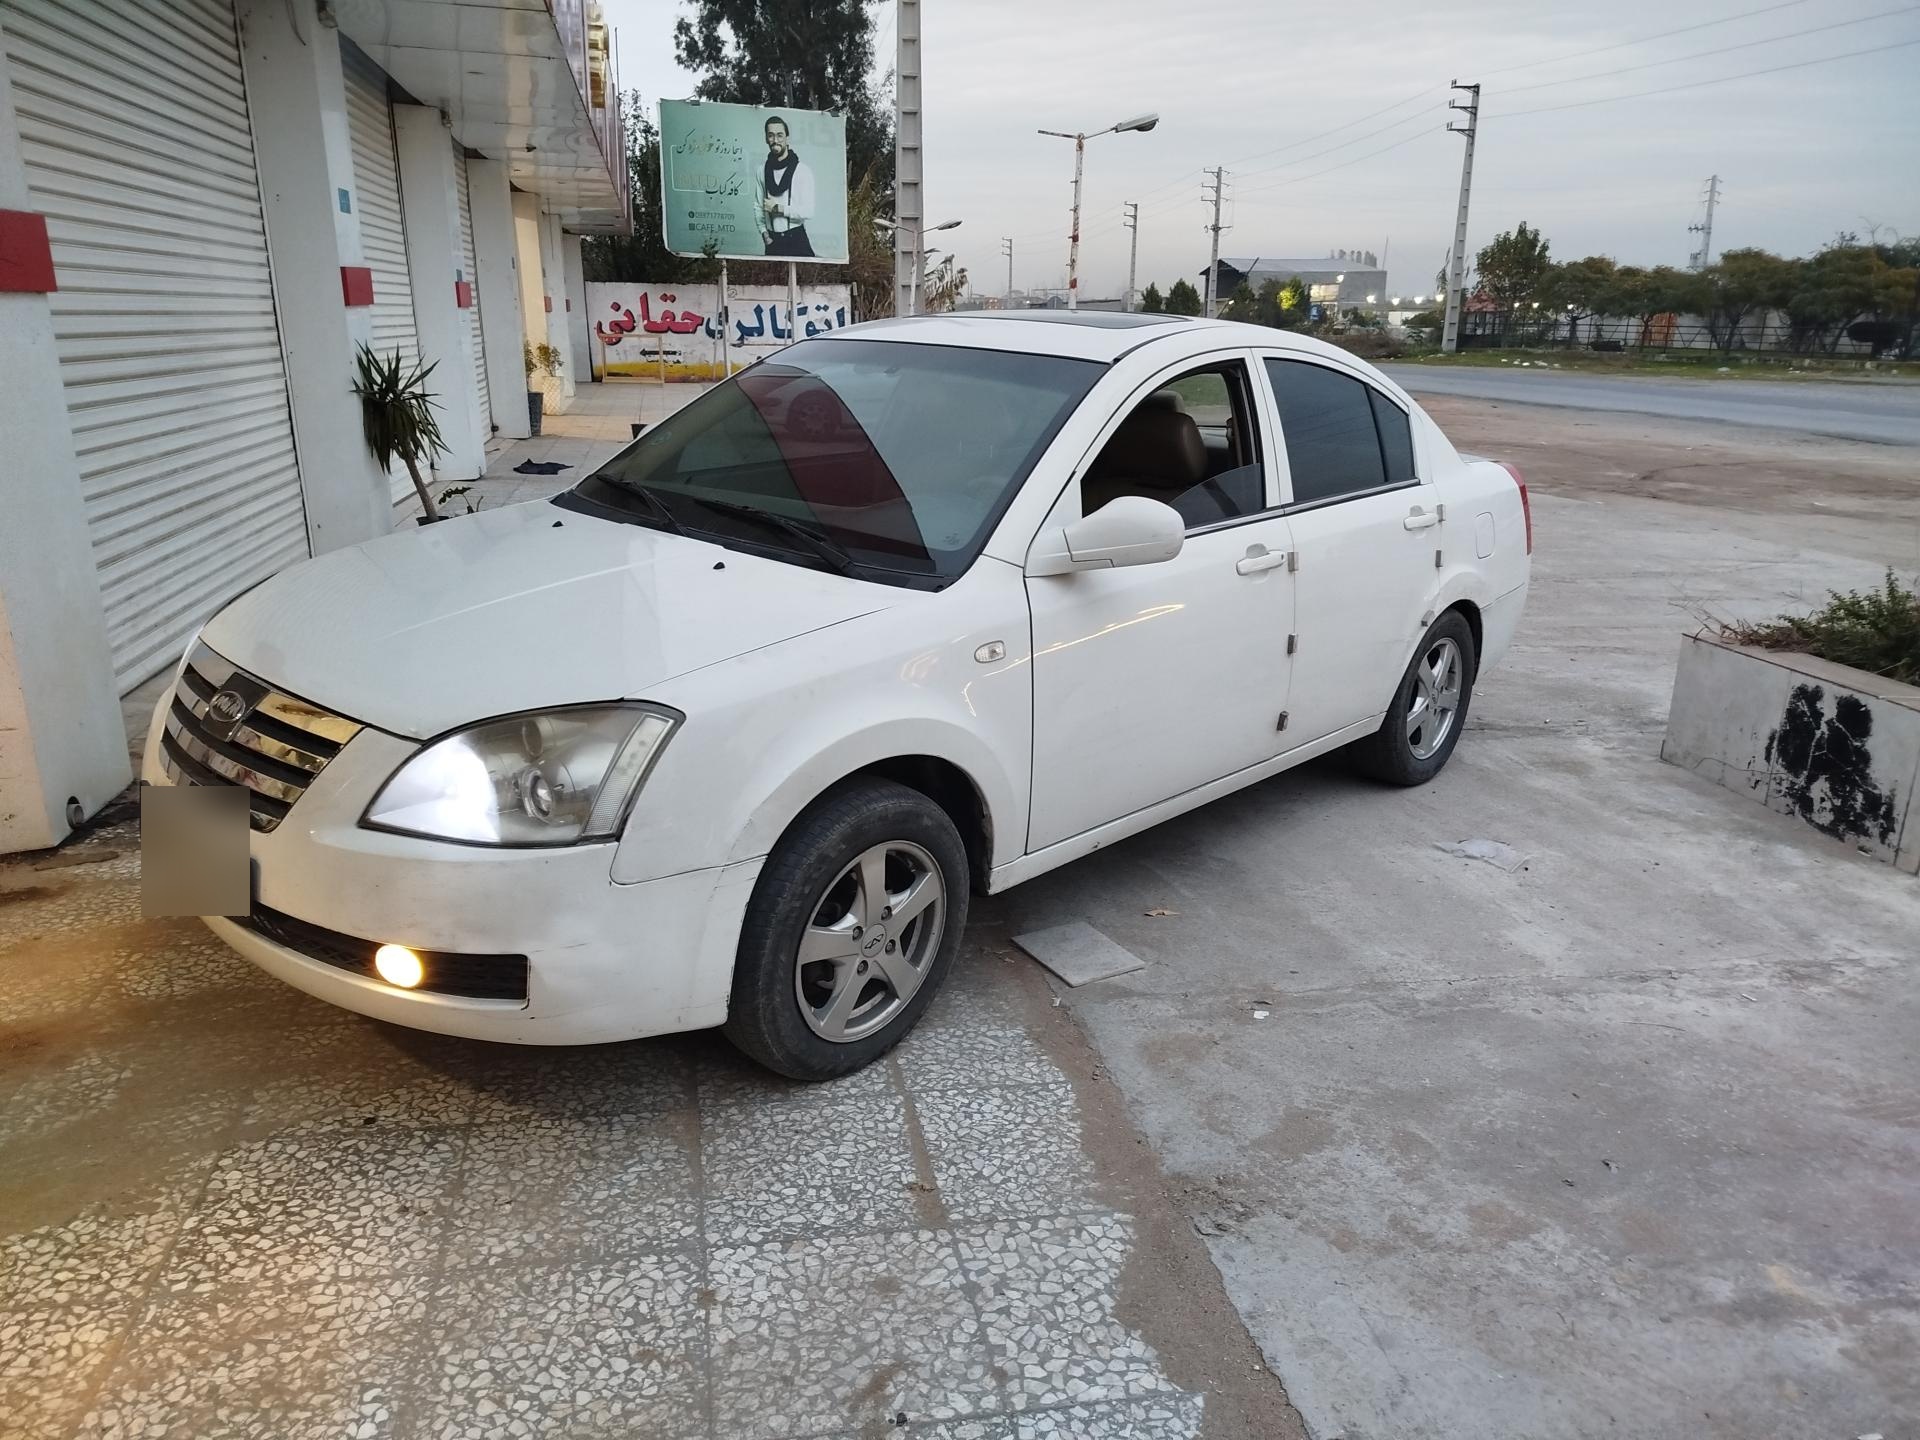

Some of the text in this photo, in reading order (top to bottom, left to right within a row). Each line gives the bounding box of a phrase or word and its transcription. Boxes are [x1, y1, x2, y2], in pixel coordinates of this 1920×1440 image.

[705, 172, 744, 204] کافه کباب
[696, 222, 736, 233] CAFE_MTD
[594, 292, 704, 345] حقانی
